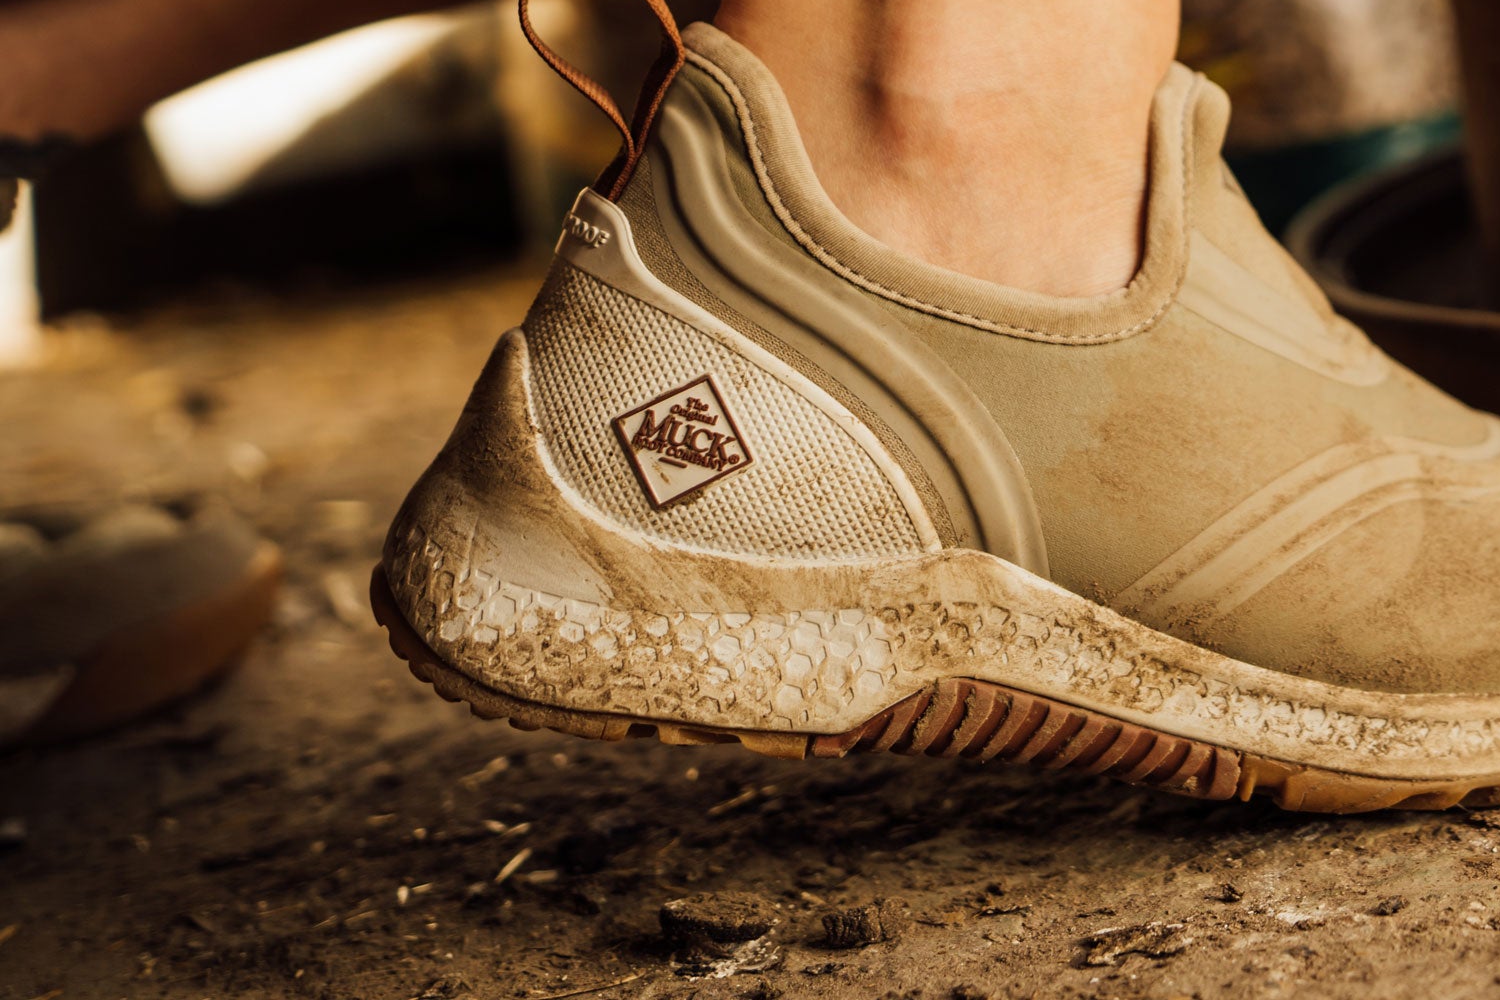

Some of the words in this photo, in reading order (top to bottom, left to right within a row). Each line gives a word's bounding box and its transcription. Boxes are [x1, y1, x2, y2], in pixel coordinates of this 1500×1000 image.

[670, 404, 719, 426] Original
[686, 396, 709, 411] The
[636, 409, 737, 462] MUCK
[665, 446, 728, 472] COMPANY
